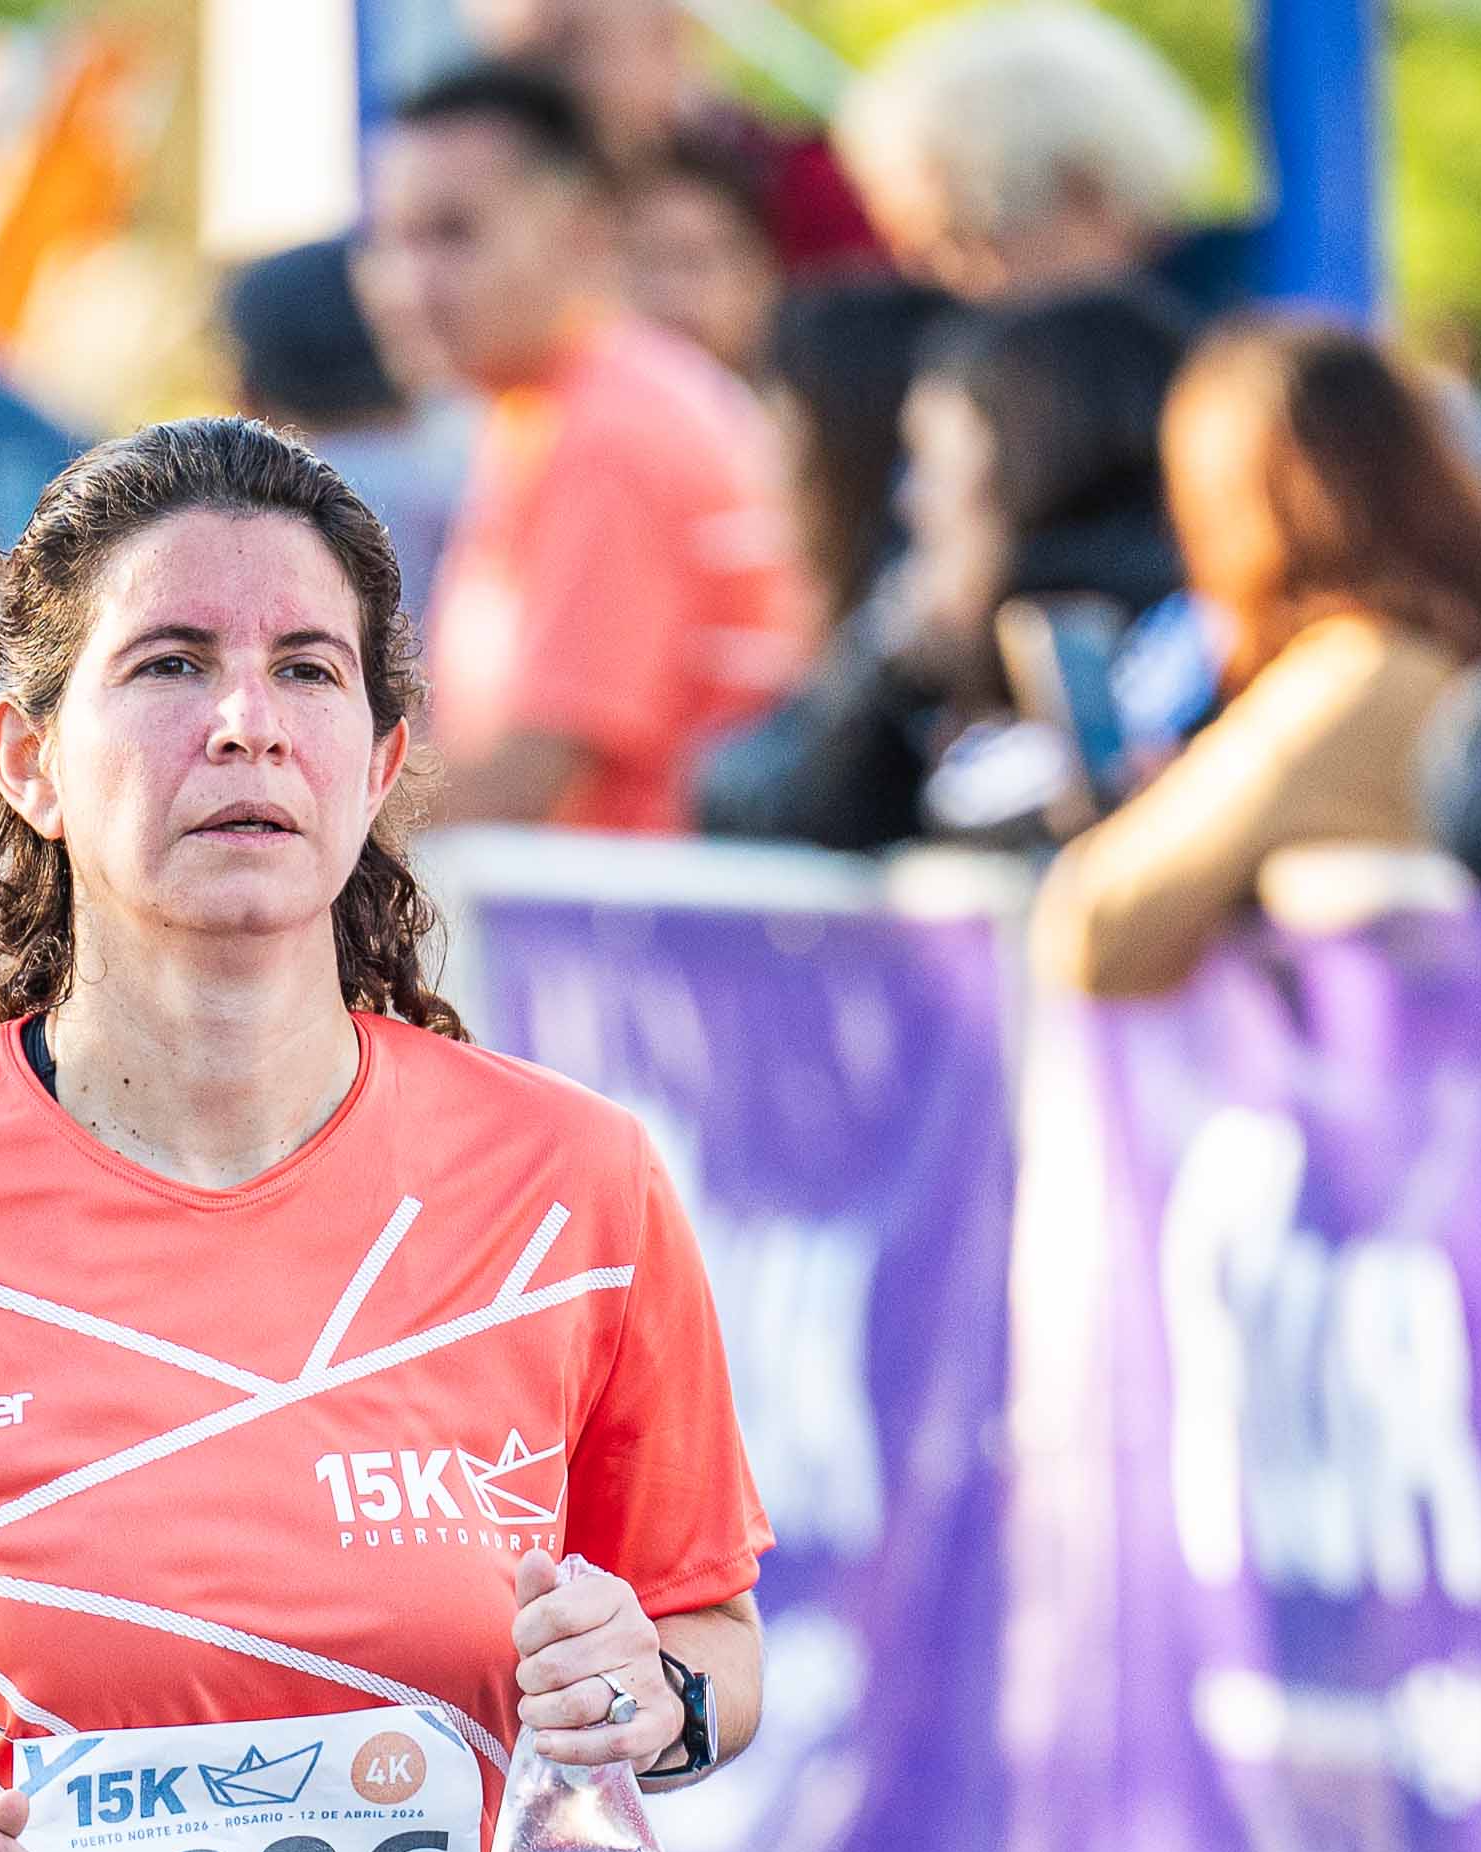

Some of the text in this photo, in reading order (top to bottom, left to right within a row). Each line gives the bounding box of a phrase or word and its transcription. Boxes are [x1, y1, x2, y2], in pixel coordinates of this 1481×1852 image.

[315, 1449, 464, 1523] 15K
[340, 1527, 557, 1551] PUERTO NORTE
[67, 1753, 411, 1828] 15K 4K
[71, 1832, 123, 1849] PUERTO
[128, 1825, 172, 1842] NORTE
[177, 1820, 210, 1835] 2026
[225, 1812, 284, 1828] ROSARIO
[300, 1810, 316, 1821] 12
[321, 1810, 338, 1820] DE
[344, 1810, 385, 1819] ABRIL
[391, 1809, 425, 1819] 2026
